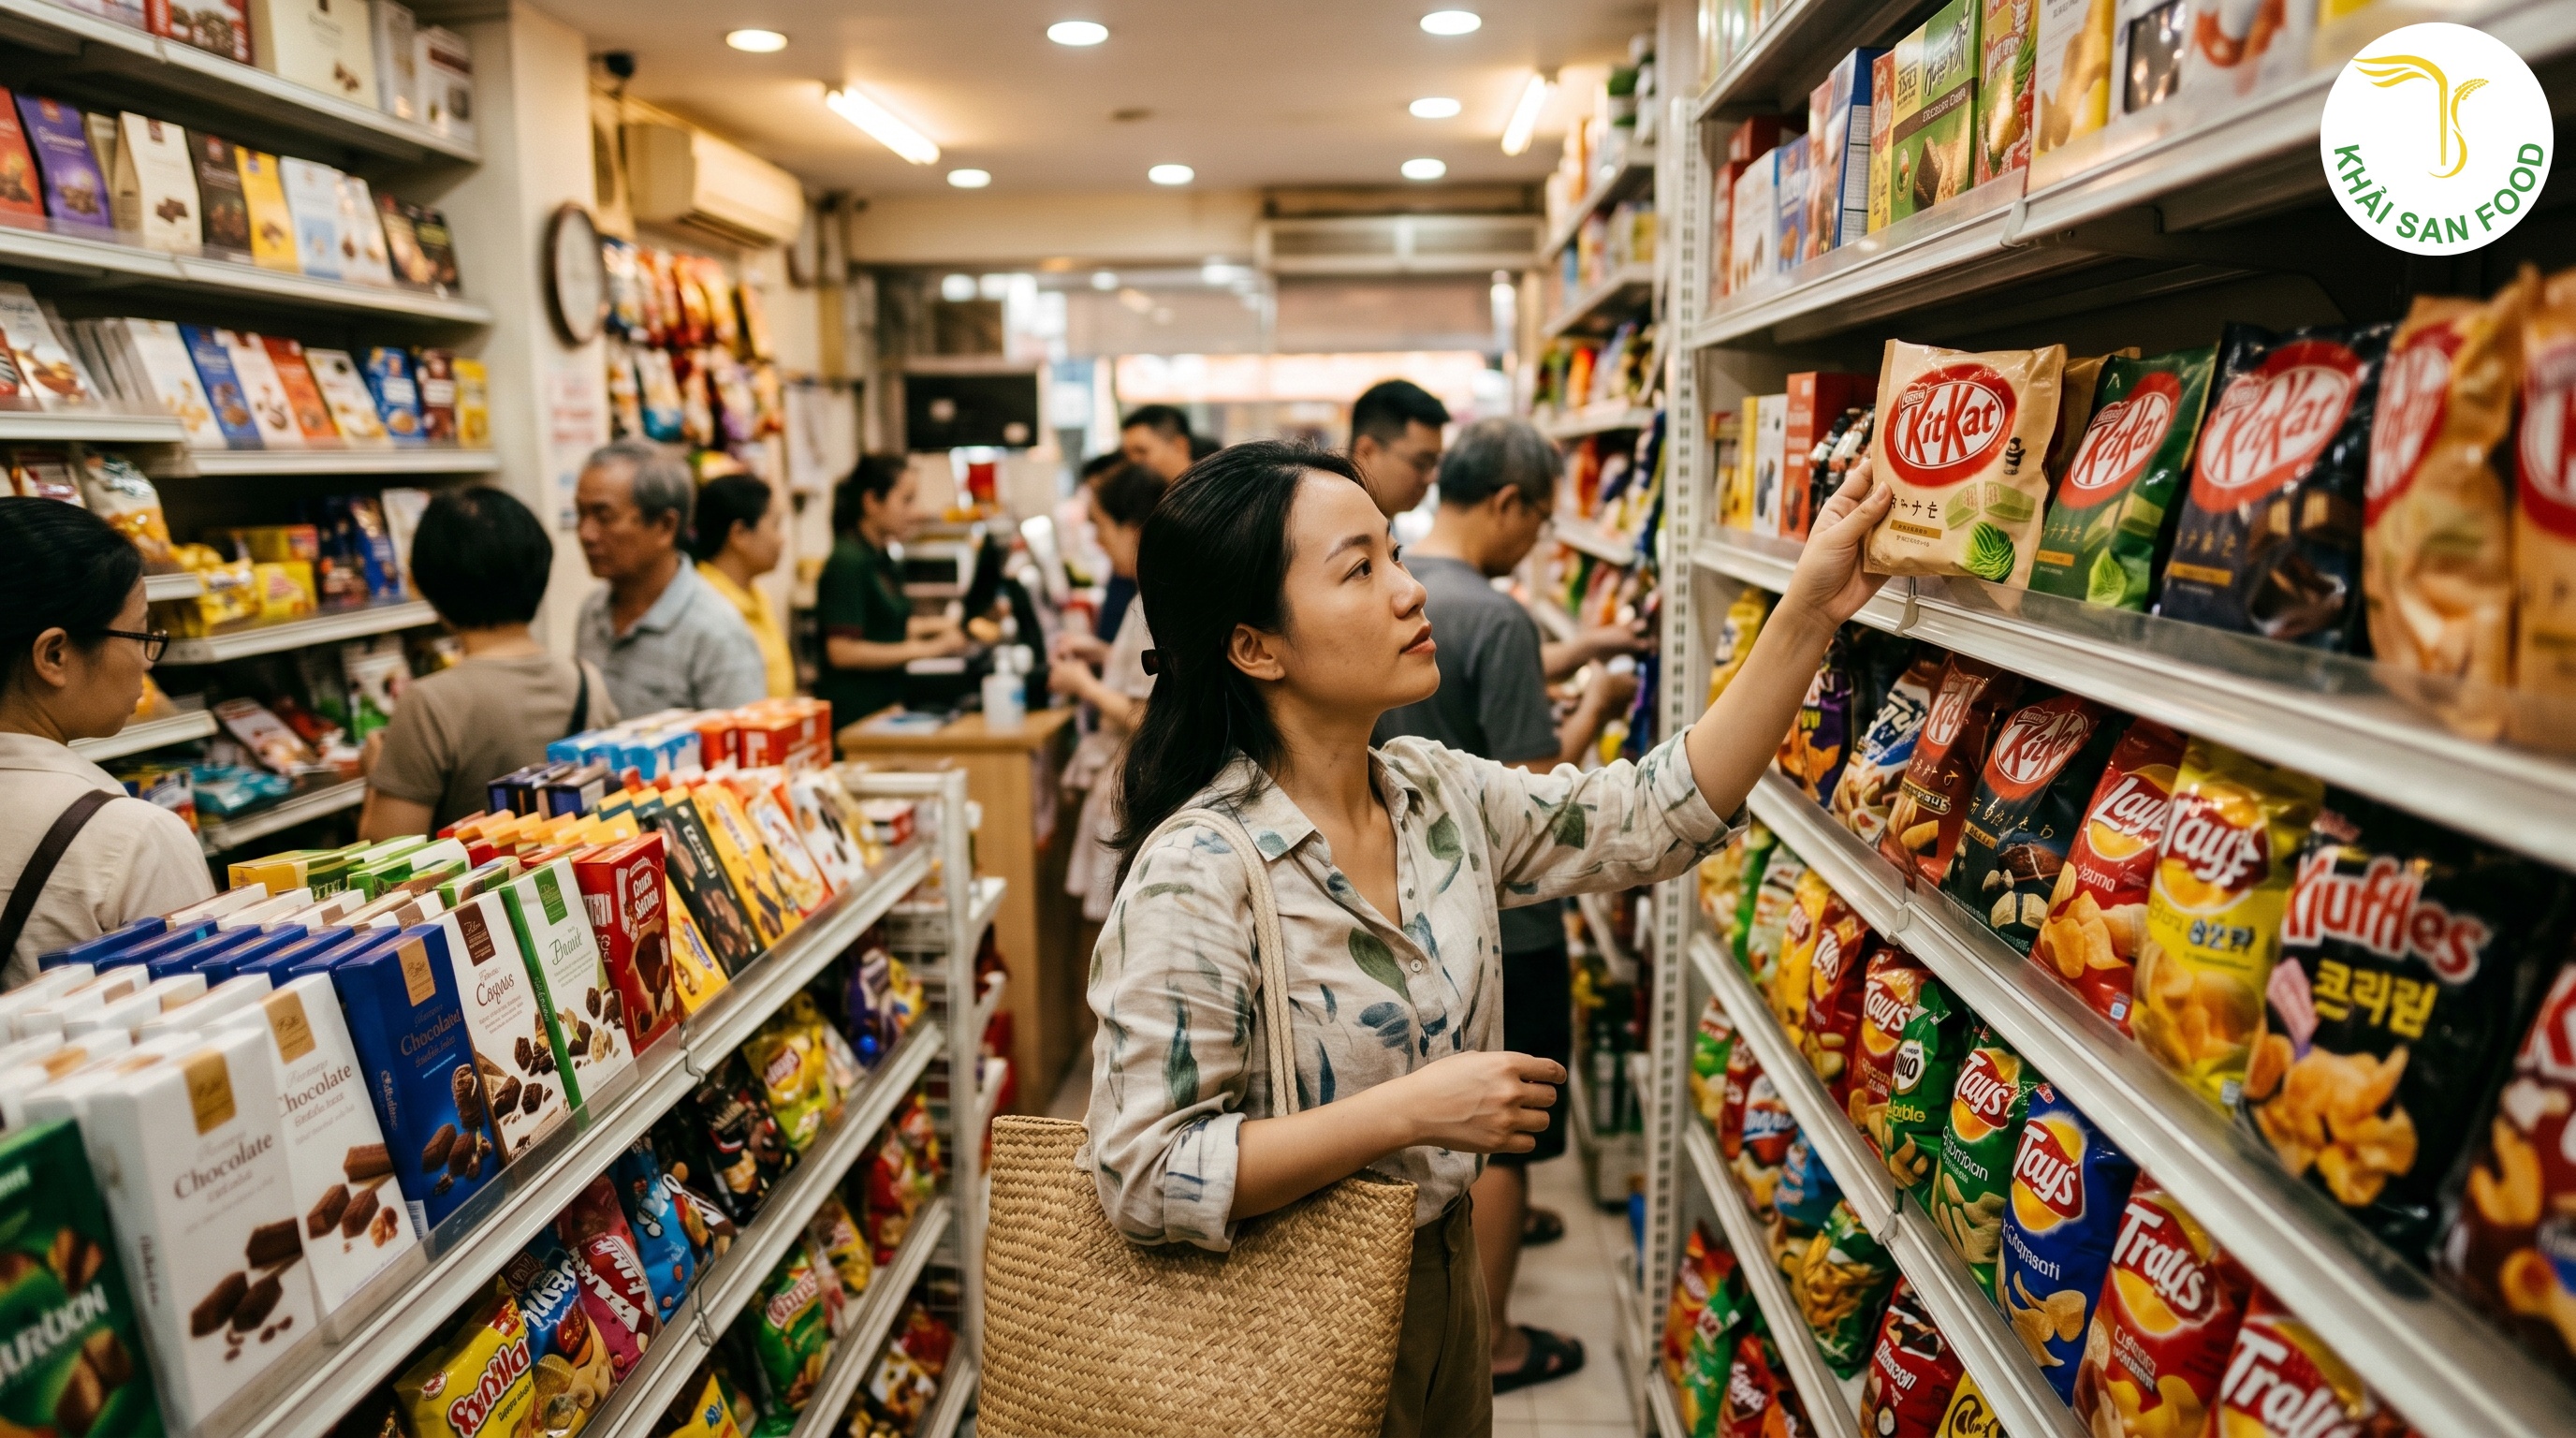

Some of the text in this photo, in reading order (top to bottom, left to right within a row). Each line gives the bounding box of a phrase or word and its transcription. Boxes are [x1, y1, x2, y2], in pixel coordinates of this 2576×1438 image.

[1904, 384, 1996, 464] KitKat
[2075, 395, 2164, 484] KitKat
[173, 1133, 273, 1200] Chocolate
